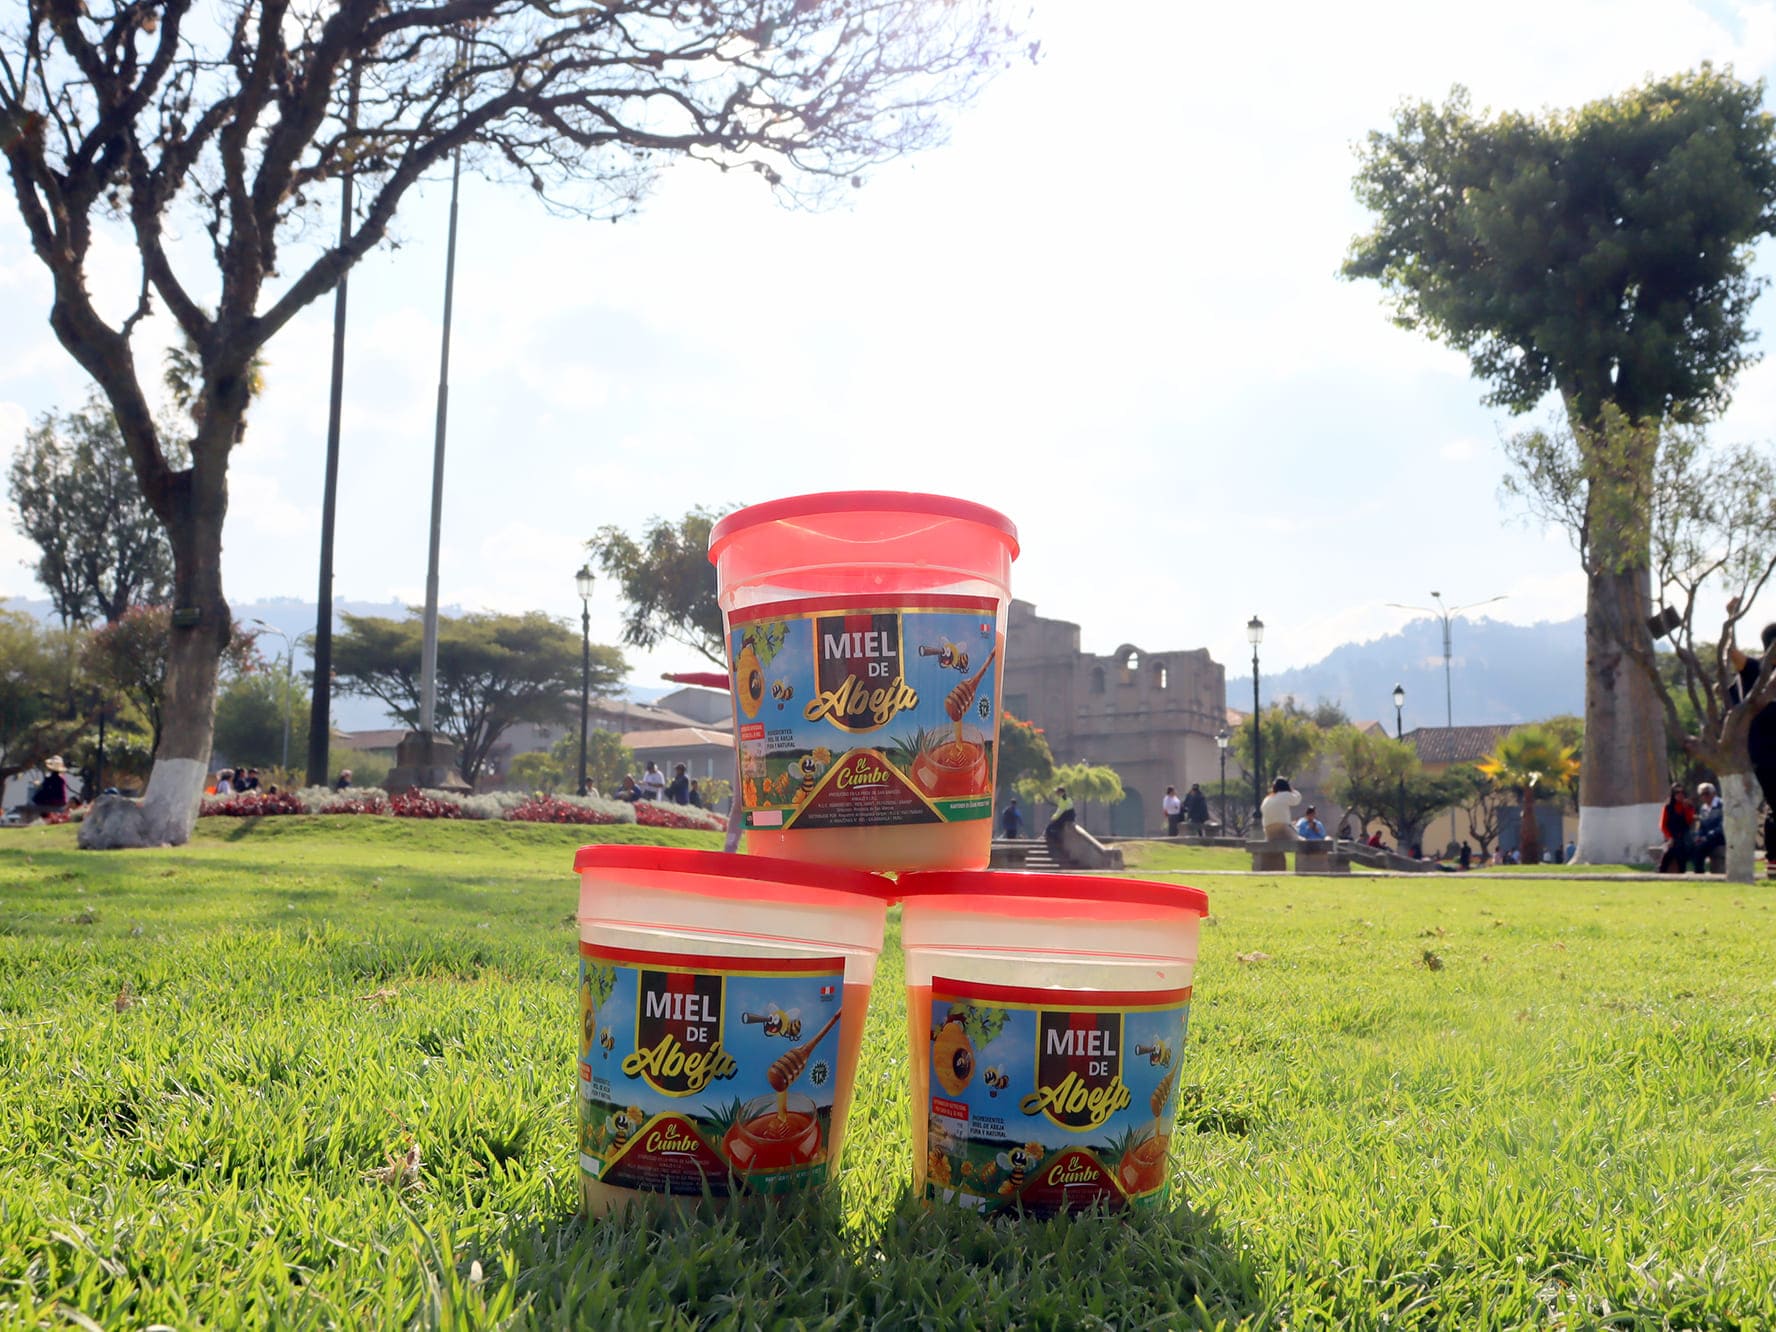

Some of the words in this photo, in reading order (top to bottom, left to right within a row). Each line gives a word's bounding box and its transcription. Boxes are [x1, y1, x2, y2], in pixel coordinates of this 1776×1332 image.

[824, 631, 896, 660] MIEL
[868, 662, 889, 677] DE
[803, 674, 919, 724] Abeja
[837, 767, 890, 790] Cumbe
[645, 990, 717, 1023] MIEL
[686, 1026, 708, 1043] DE
[1046, 1028, 1117, 1057] MIEL
[621, 1033, 739, 1090] Abeja
[1088, 1060, 1108, 1076] DE
[1019, 1071, 1132, 1124] Abeja
[646, 1132, 699, 1153] Cumbe
[1047, 1165, 1100, 1186] Cumbe
